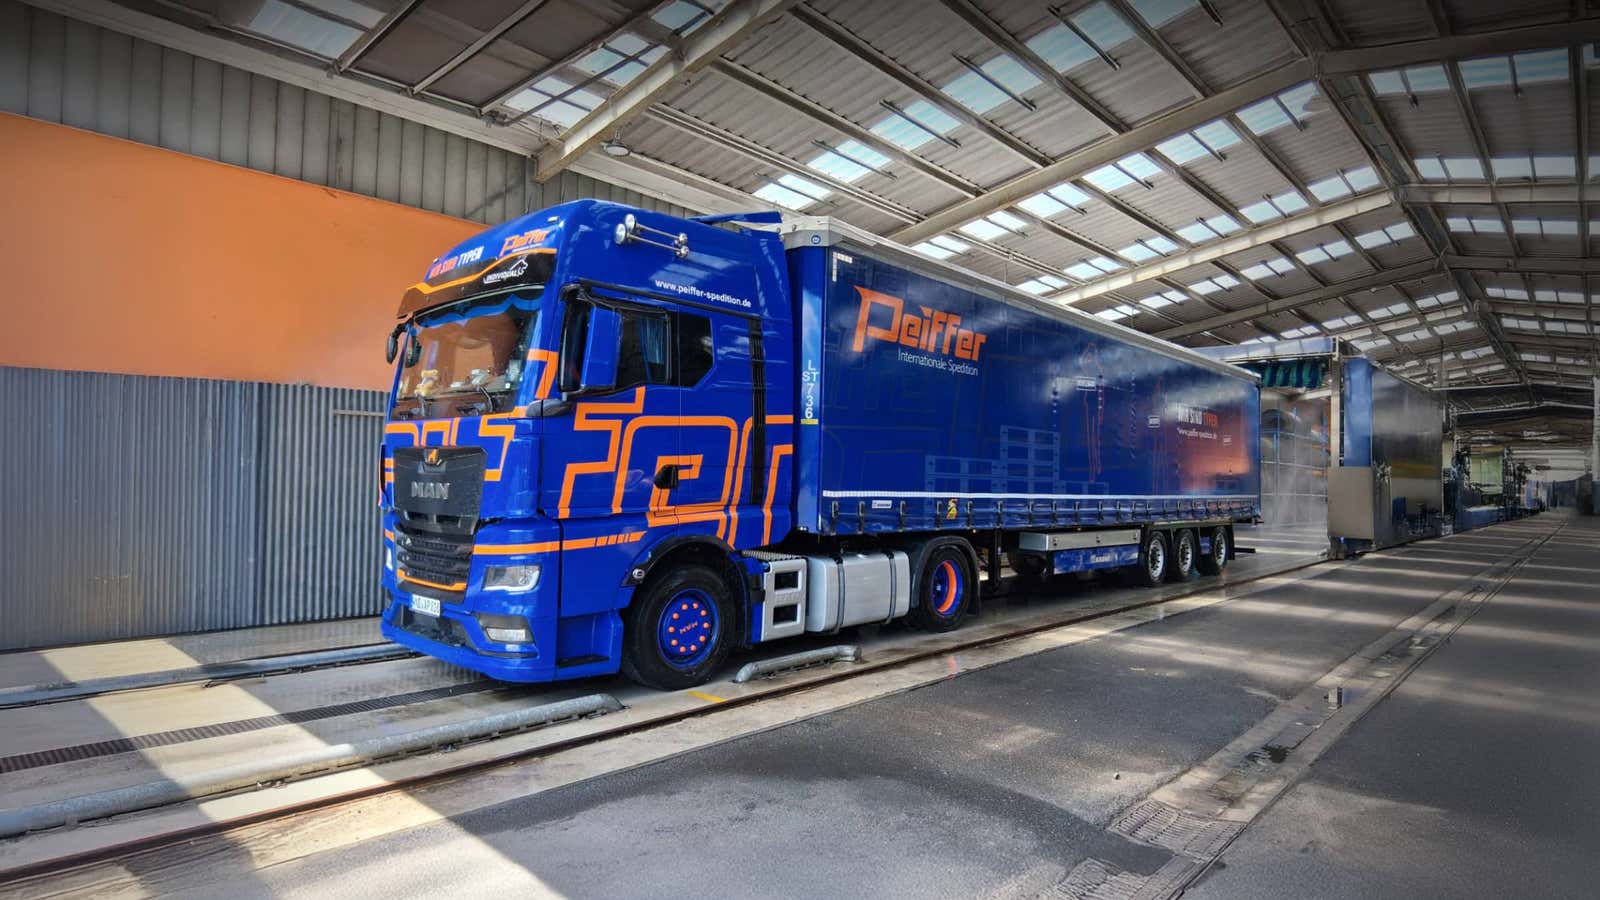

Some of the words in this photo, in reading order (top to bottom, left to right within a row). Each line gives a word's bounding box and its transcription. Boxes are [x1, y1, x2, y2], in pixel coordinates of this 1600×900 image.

[655, 279, 752, 309] www.peiffer-spedition.de
[853, 285, 987, 362] Peiffer
[898, 348, 947, 371] Internationale
[947, 360, 979, 377] Spedition
[411, 480, 450, 500] MAN
